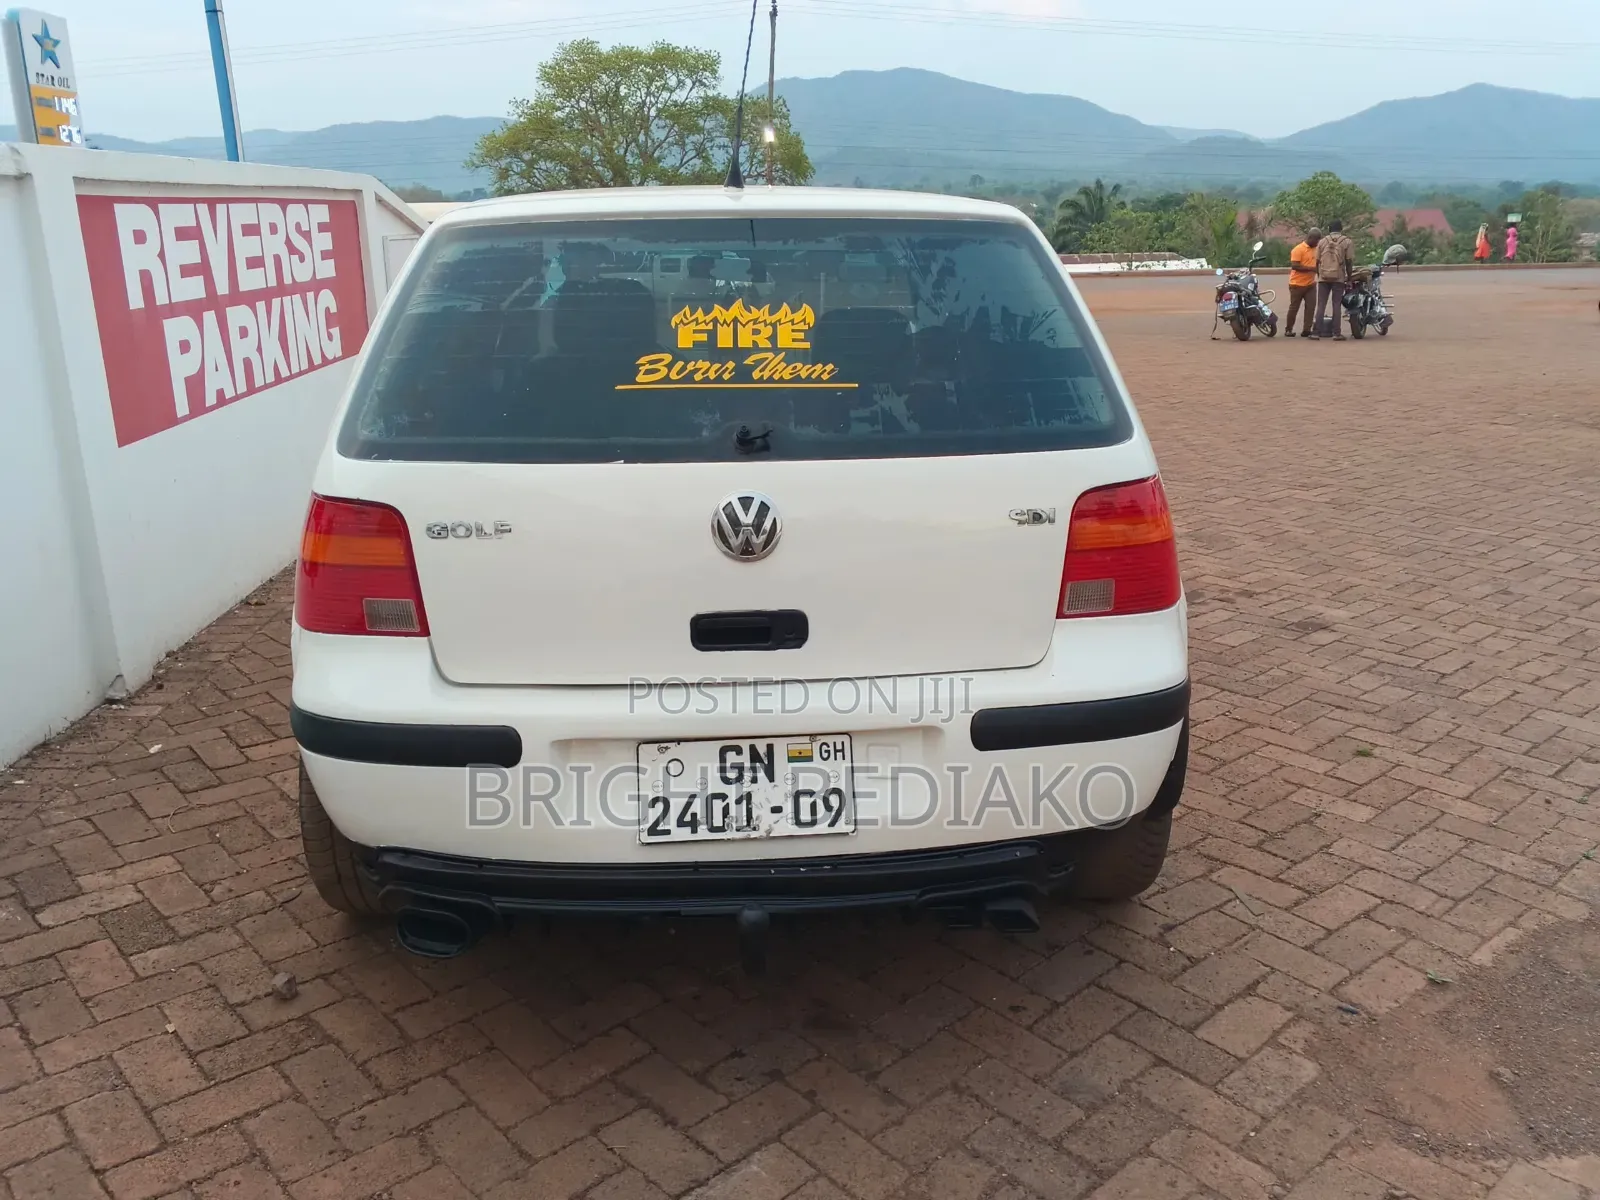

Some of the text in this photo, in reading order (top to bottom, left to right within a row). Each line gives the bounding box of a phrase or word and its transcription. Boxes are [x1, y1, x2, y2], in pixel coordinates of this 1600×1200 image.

[35, 72, 70, 89] STAR OIL
[113, 202, 337, 310] REVERSE
[677, 320, 811, 348] FIRE
[162, 288, 343, 419] PARKING
[743, 351, 839, 382] Them
[425, 520, 512, 540] GOLF
[718, 741, 846, 786] GN GH
